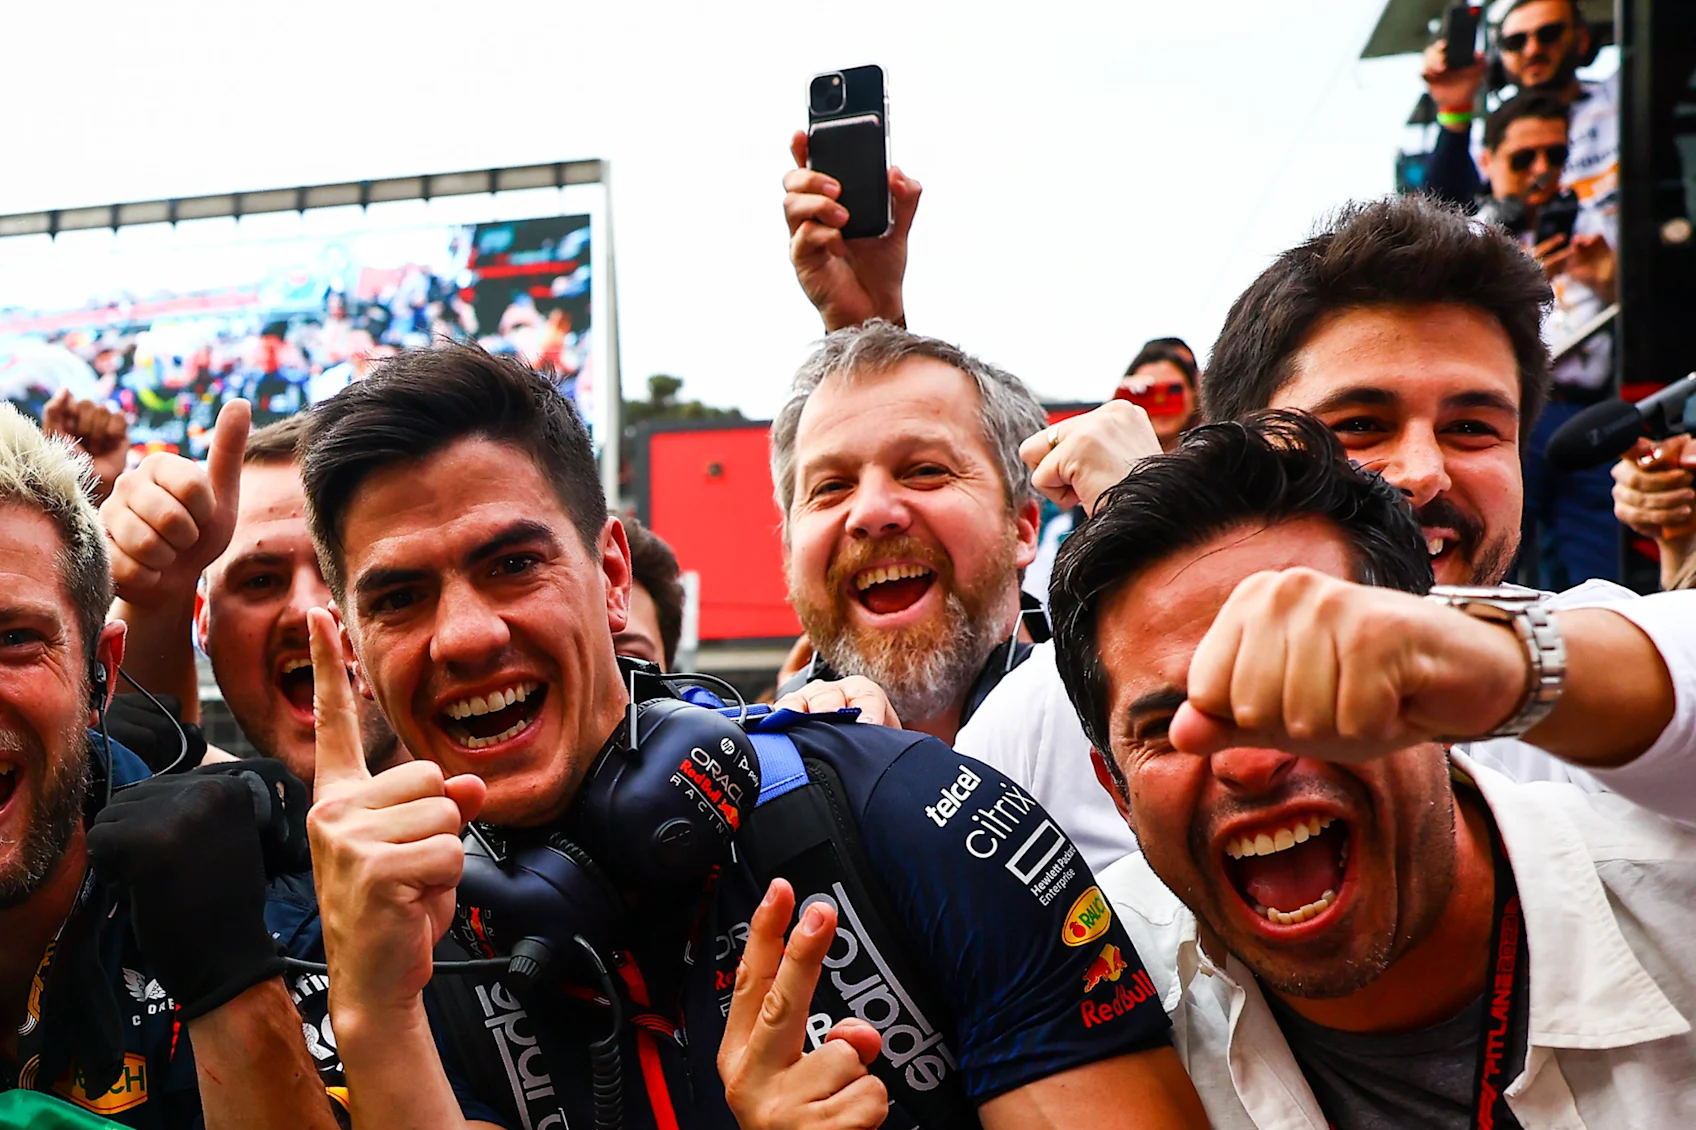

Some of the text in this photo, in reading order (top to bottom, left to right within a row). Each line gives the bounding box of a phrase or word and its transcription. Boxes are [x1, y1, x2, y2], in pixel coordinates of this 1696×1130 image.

[669, 774, 725, 835] RACIN
[690, 746, 744, 808] ORACL
[924, 764, 982, 828] telcel
[965, 781, 1037, 859] citrix
[1031, 862, 1063, 897] Hewlett
[1038, 867, 1077, 907] Enterprise
[1078, 896, 1107, 929] RAUC
